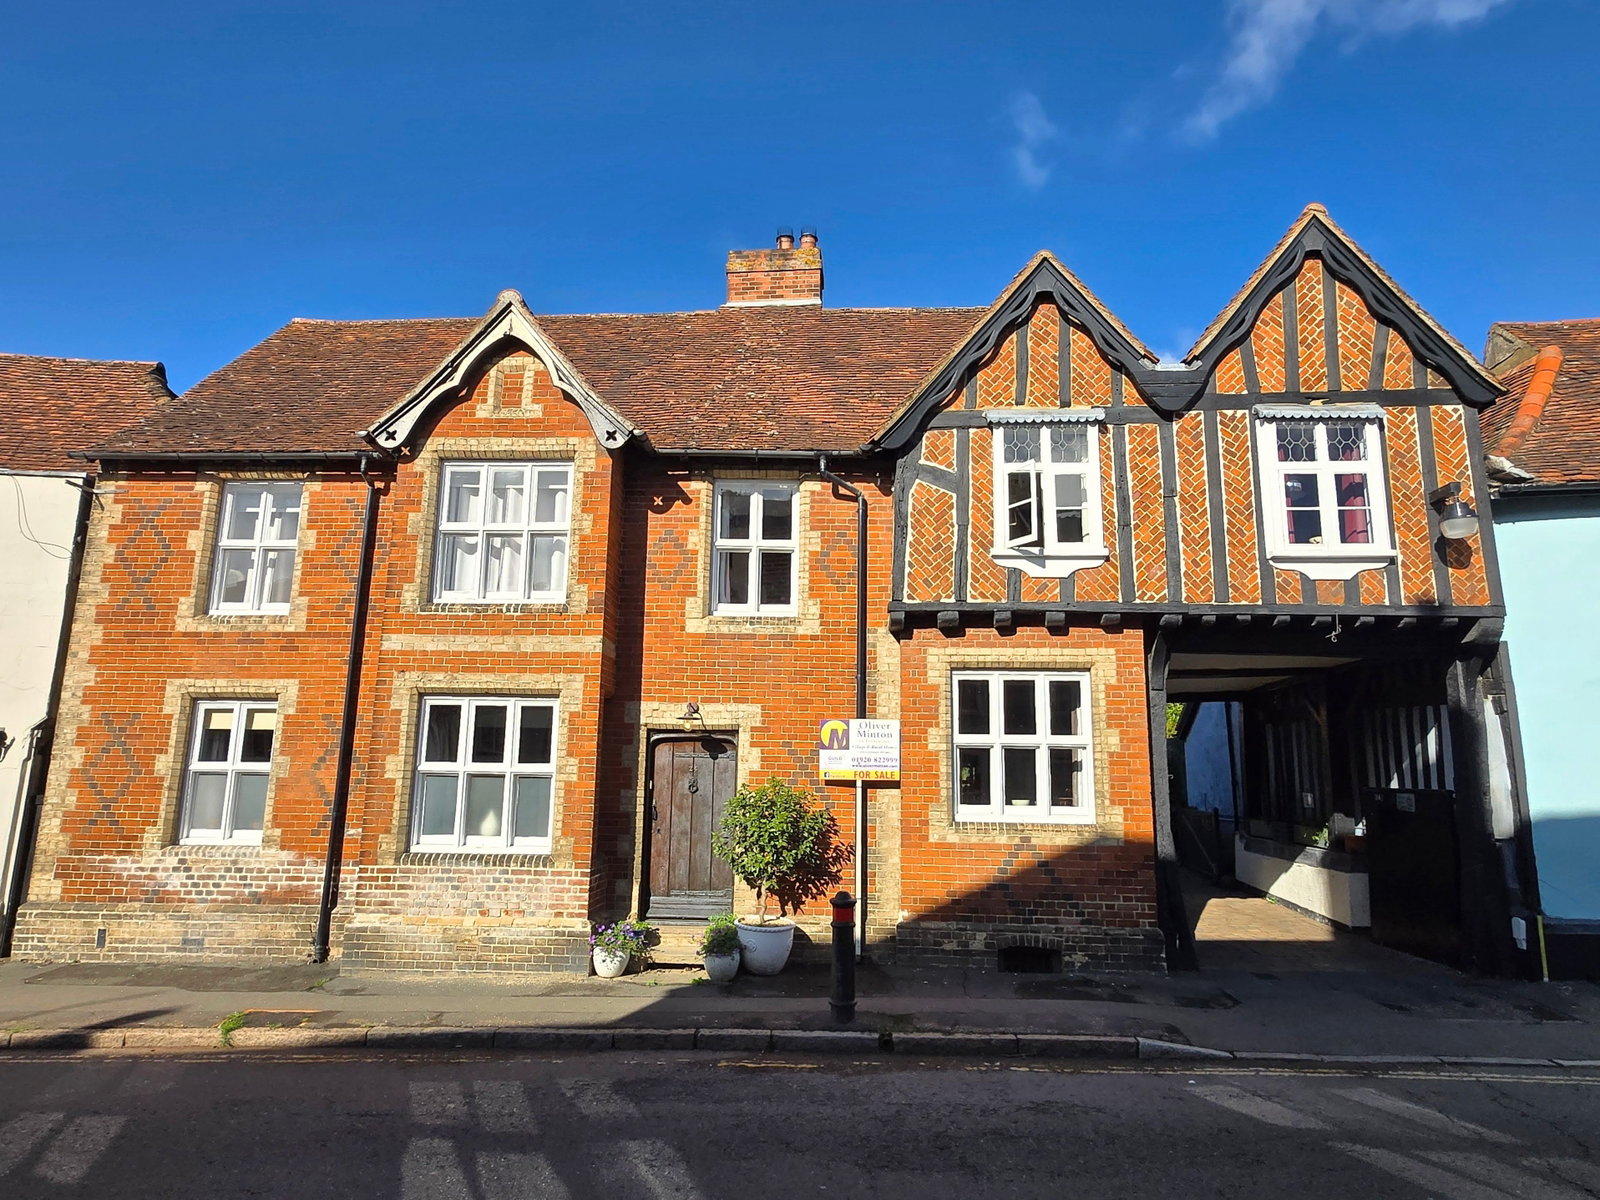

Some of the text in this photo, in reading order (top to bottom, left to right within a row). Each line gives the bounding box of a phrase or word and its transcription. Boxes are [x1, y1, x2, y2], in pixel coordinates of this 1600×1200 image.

[859, 721, 891, 730] Oliver
[857, 730, 893, 739] Minton
[853, 770, 871, 779] FOR
[874, 770, 896, 779] SALE
